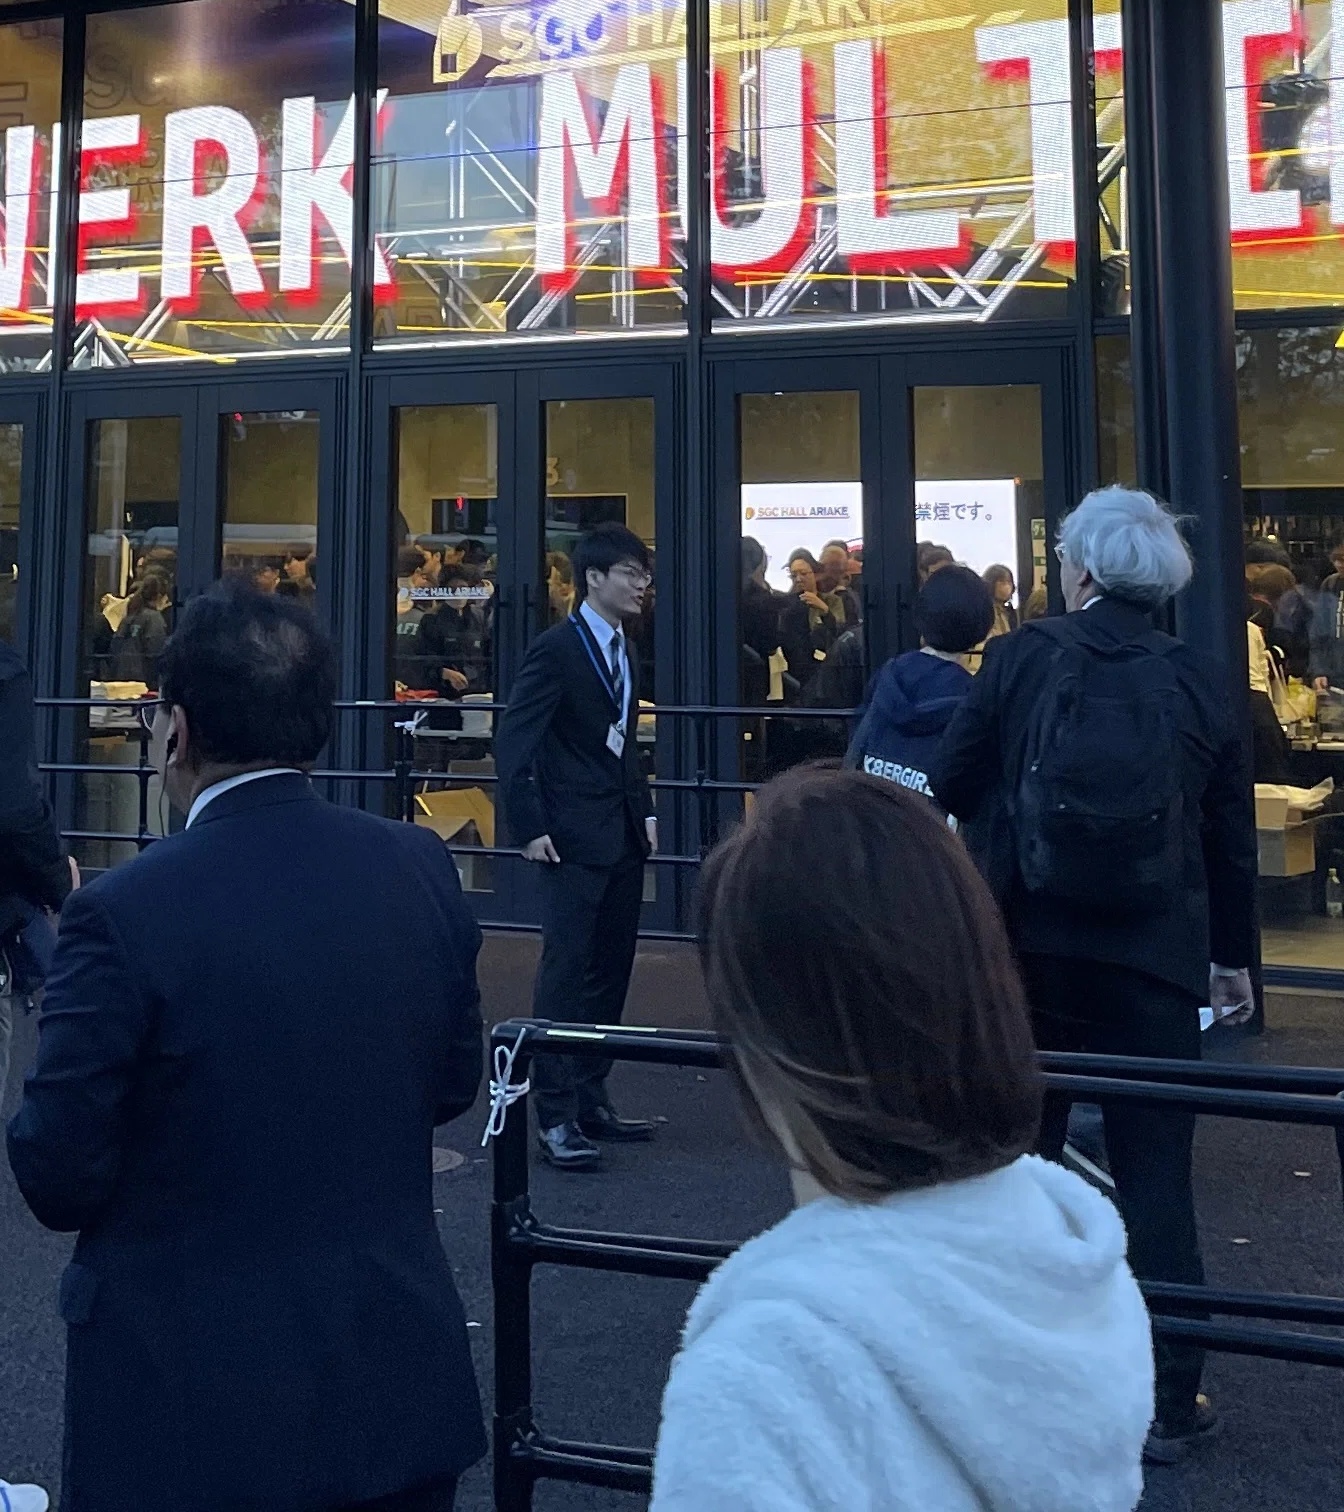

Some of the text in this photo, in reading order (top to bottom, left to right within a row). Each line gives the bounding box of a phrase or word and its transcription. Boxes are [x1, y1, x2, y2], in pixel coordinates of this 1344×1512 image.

[757, 506, 849, 517] SGC HALL ARIAKE
[915, 501, 993, 522] 禁煙です。
